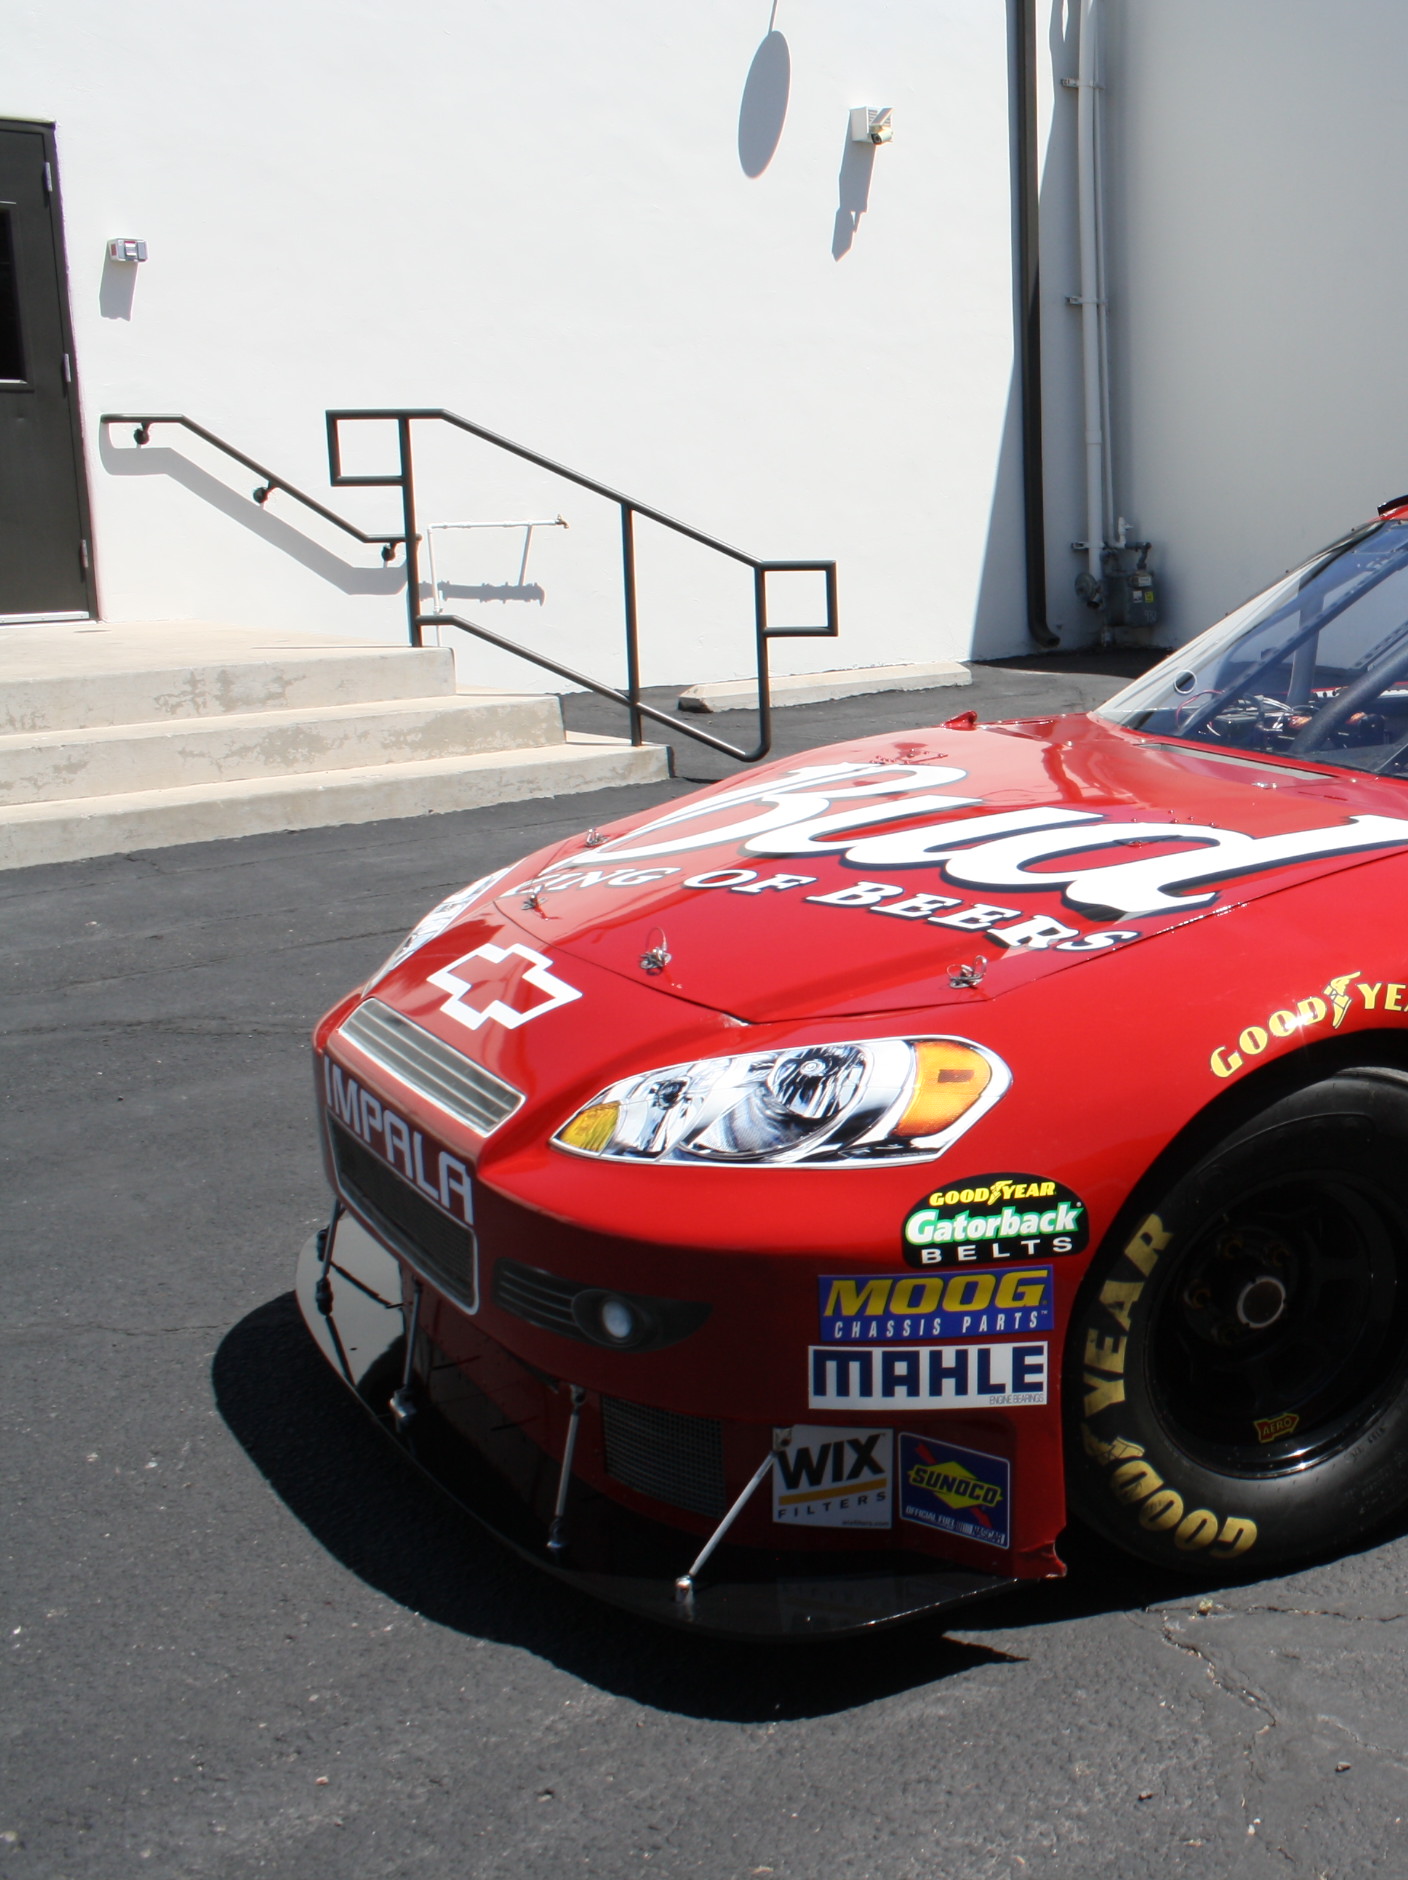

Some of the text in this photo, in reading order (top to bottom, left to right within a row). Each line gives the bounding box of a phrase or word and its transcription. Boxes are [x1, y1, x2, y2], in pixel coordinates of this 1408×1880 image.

[682, 868, 818, 895] OF
[806, 880, 1142, 954] BEERS
[323, 1053, 475, 1226] IMPALA
[929, 1179, 1057, 1207] GOODYEAR
[905, 1201, 1084, 1247] Gatorback
[920, 1236, 1073, 1265] BELTS
[823, 1269, 1049, 1317] MOOG
[834, 1310, 1039, 1339] CHASSIS PARTS
[812, 1345, 1045, 1398] MAHLE
[988, 1392, 1044, 1406] ENGINE BEARINGS
[1262, 1416, 1293, 1437] AERO
[776, 1433, 886, 1491] WIX
[911, 1466, 1000, 1506] SUNOCO
[777, 1490, 887, 1519] FILTERS
[904, 1504, 937, 1523] OFFICIAL
[937, 1513, 956, 1531] FUEL
